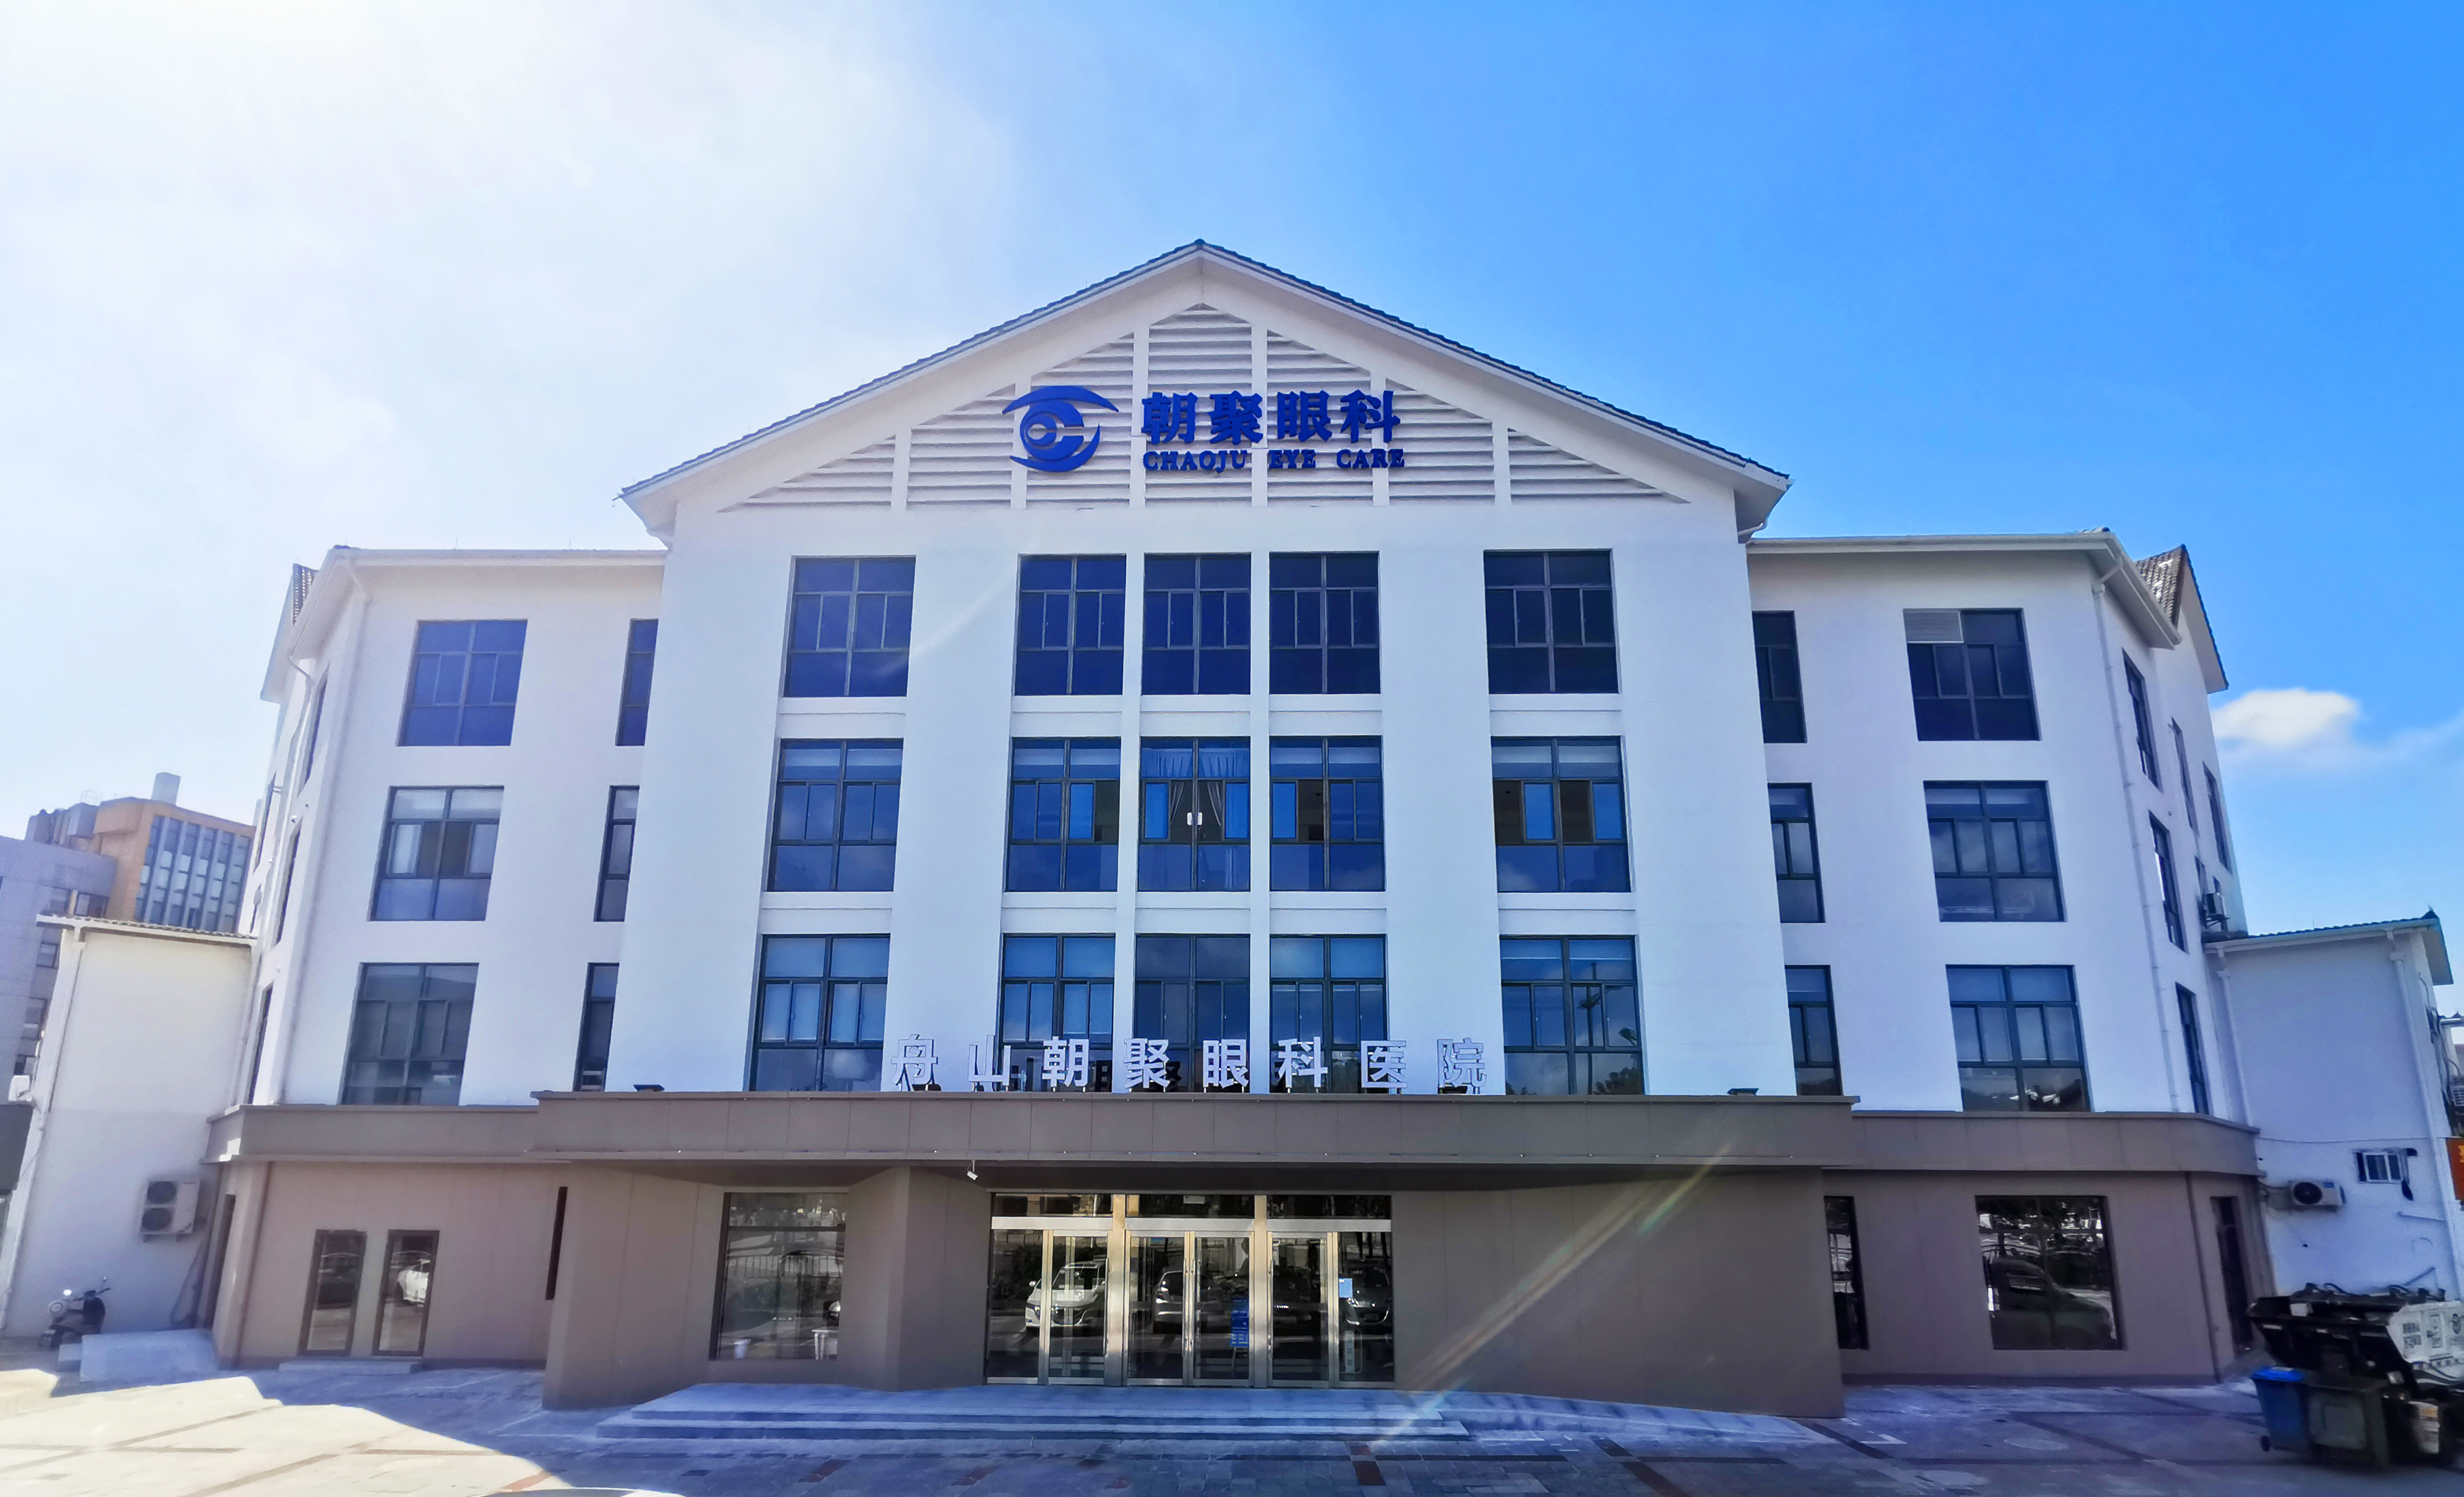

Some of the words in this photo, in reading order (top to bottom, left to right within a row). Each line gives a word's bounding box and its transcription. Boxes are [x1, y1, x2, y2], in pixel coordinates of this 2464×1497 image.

[1141, 390, 1400, 445] 朝聚眼科
[1143, 450, 1248, 473] CHAOJU
[1268, 449, 1316, 469] EYE
[1336, 449, 1405, 469] CARE
[890, 1034, 1488, 1089] 舟山朝聚眼科医院
